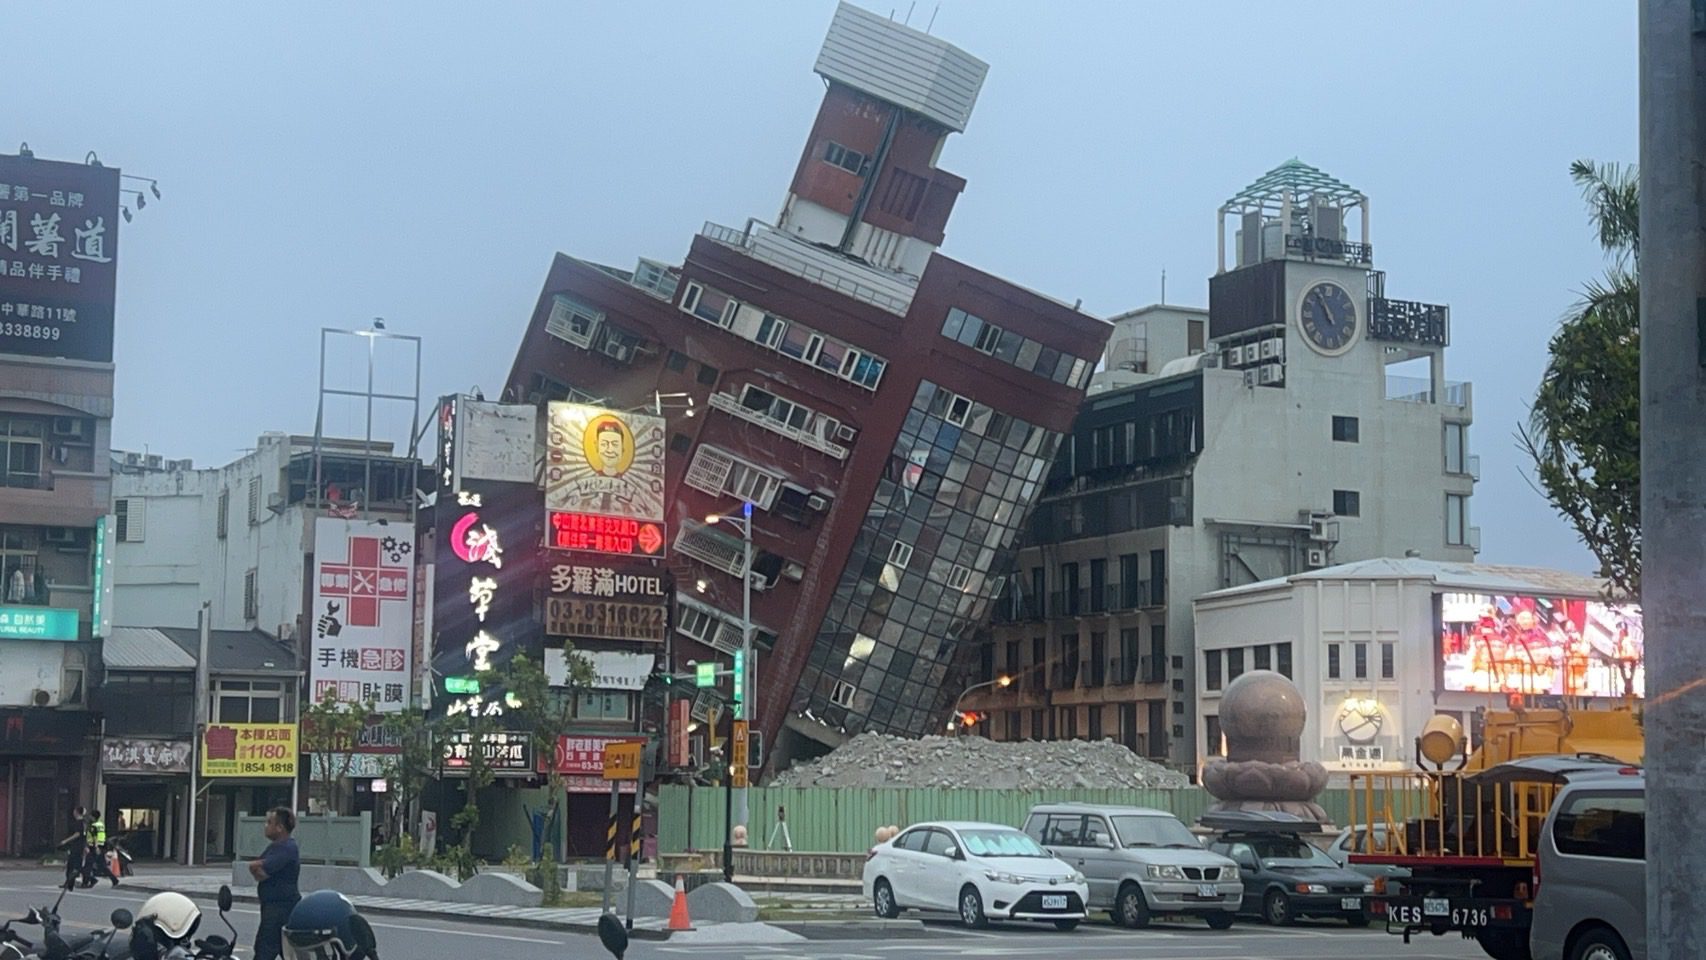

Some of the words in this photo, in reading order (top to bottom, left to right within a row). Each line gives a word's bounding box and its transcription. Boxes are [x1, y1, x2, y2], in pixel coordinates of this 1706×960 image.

[1, 301, 76, 323] 中華路11號
[317, 647, 405, 671] 手機急診
[248, 744, 286, 759] 1180
[270, 763, 293, 773] 1818
[1388, 906, 1421, 923] KES
[1452, 908, 1487, 926] 6736
